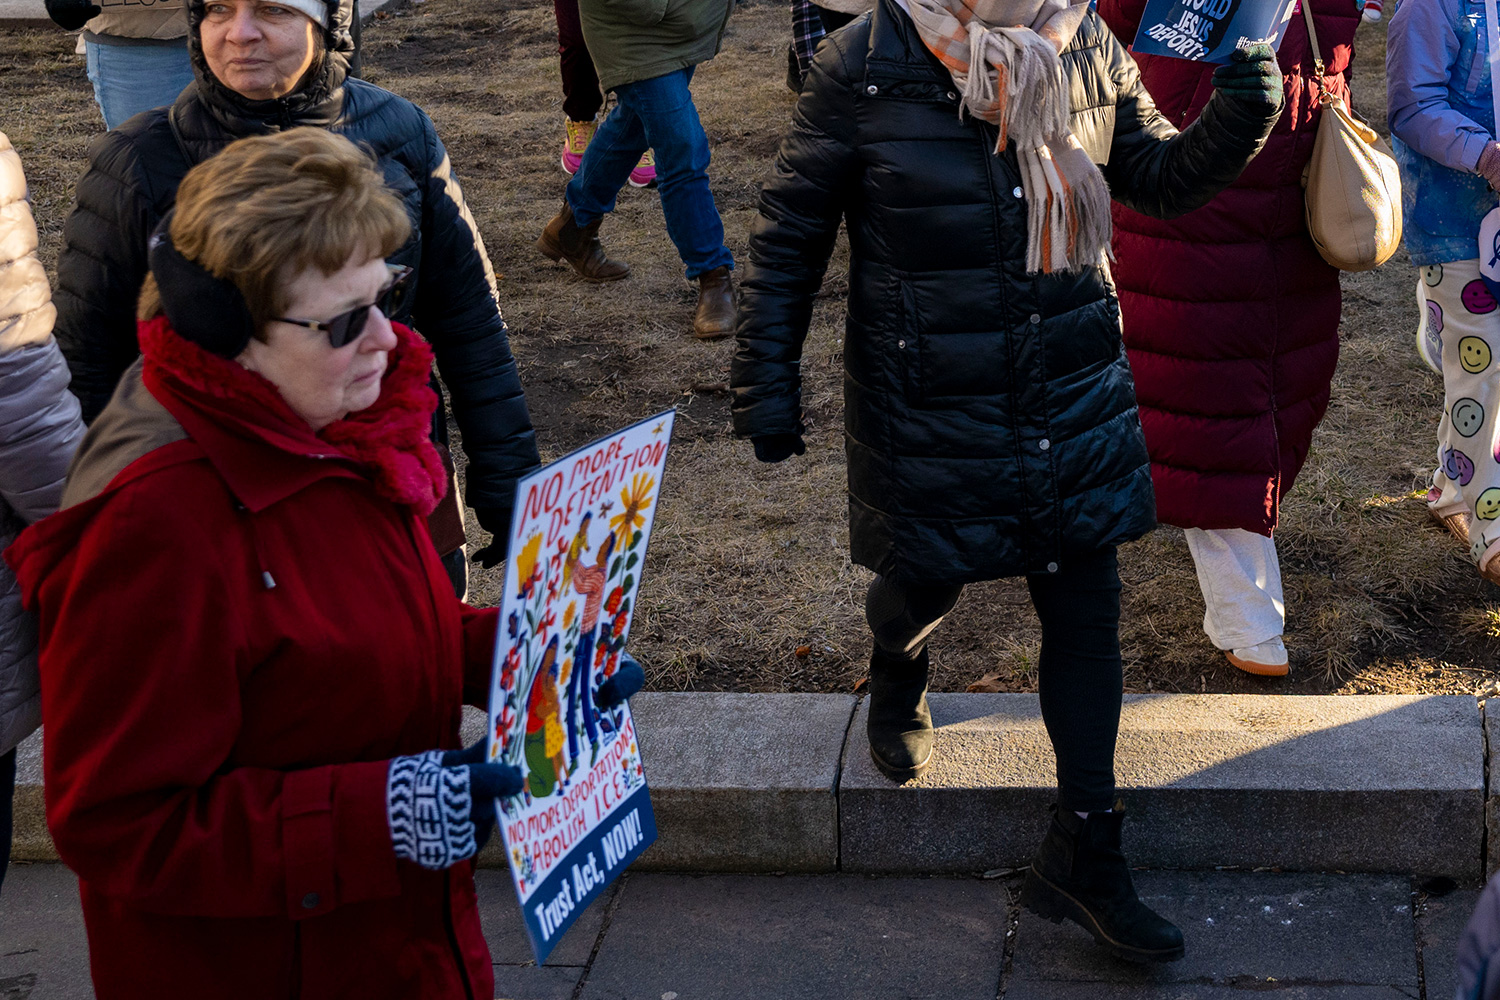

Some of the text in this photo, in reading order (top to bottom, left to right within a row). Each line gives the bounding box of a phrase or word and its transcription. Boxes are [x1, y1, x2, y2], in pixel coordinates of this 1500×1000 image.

[1143, 23, 1210, 61] DEPORT?
[1172, 10, 1214, 42] JESUS
[518, 436, 626, 539] NO MORE
[546, 439, 668, 548] DETENTION
[508, 717, 634, 847] NO MORE DEPORTATIONS
[533, 815, 587, 872] ABOLISH
[534, 807, 645, 942] Trust Act, NOW!
